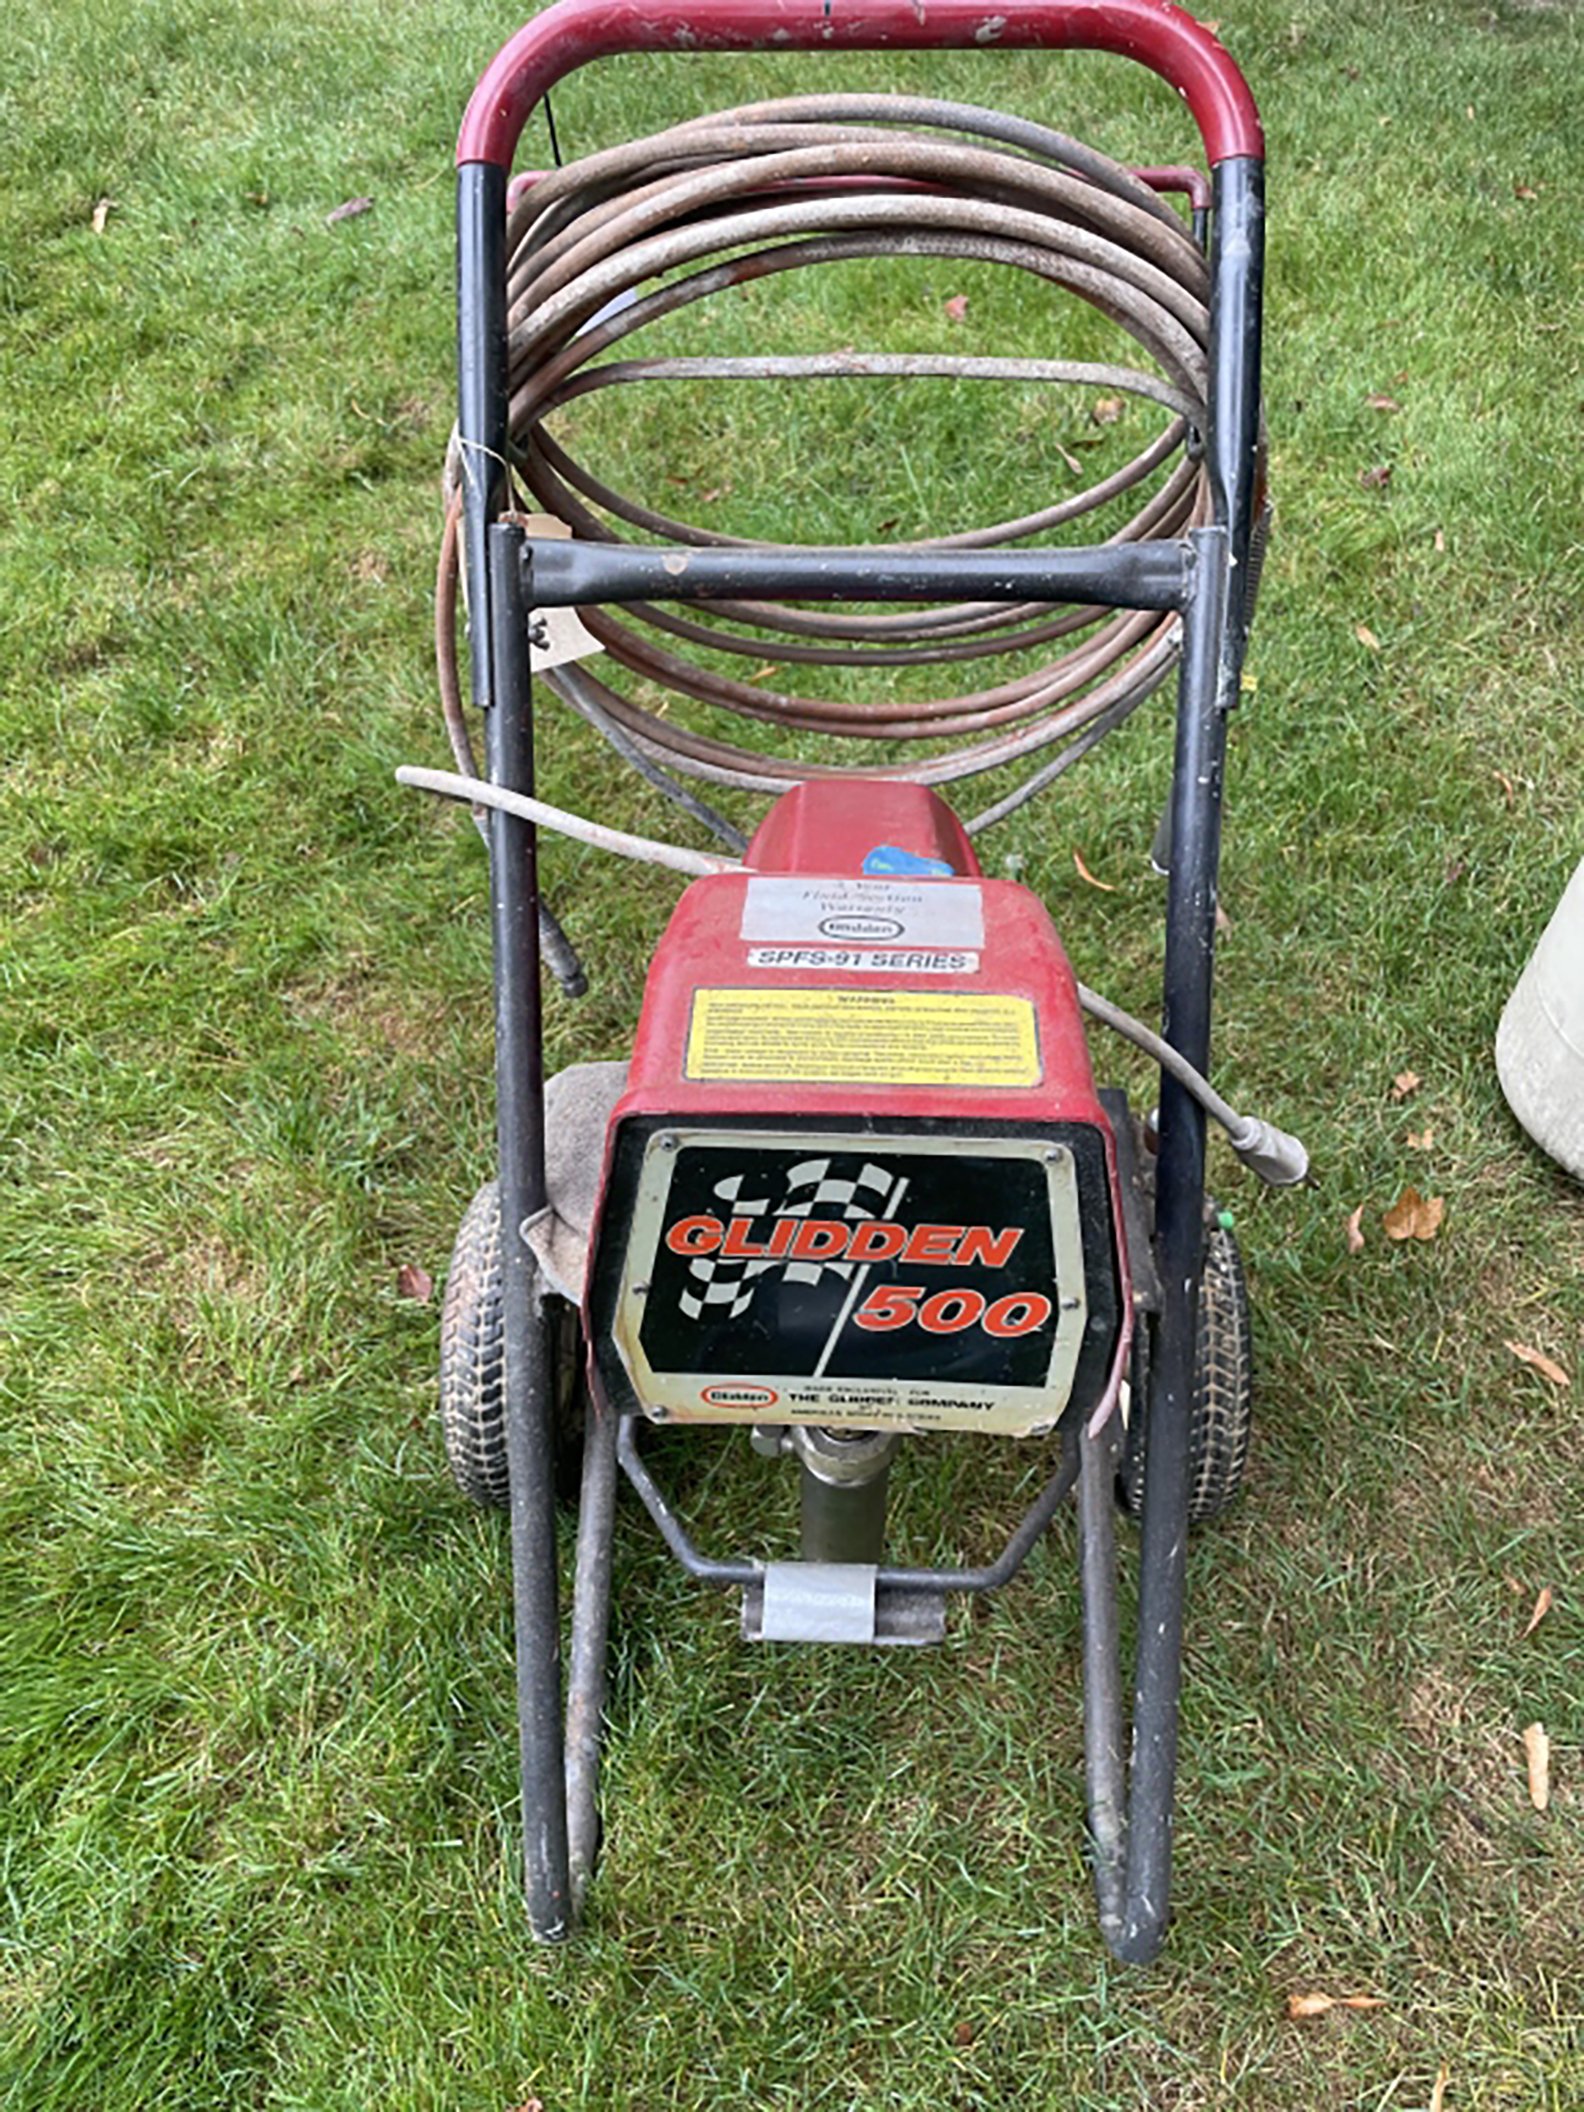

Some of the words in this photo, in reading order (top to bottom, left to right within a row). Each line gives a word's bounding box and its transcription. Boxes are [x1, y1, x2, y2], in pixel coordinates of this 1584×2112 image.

[820, 901, 905, 914] Warranty
[758, 950, 862, 967] SPFS-91
[870, 952, 966, 970] SERIES
[665, 1214, 1025, 1268] GLIDDEN
[852, 1284, 1053, 1338] 500
[710, 1390, 769, 1401] Glidden
[788, 1392, 821, 1403] THE
[907, 1397, 996, 1411] COMPANY
